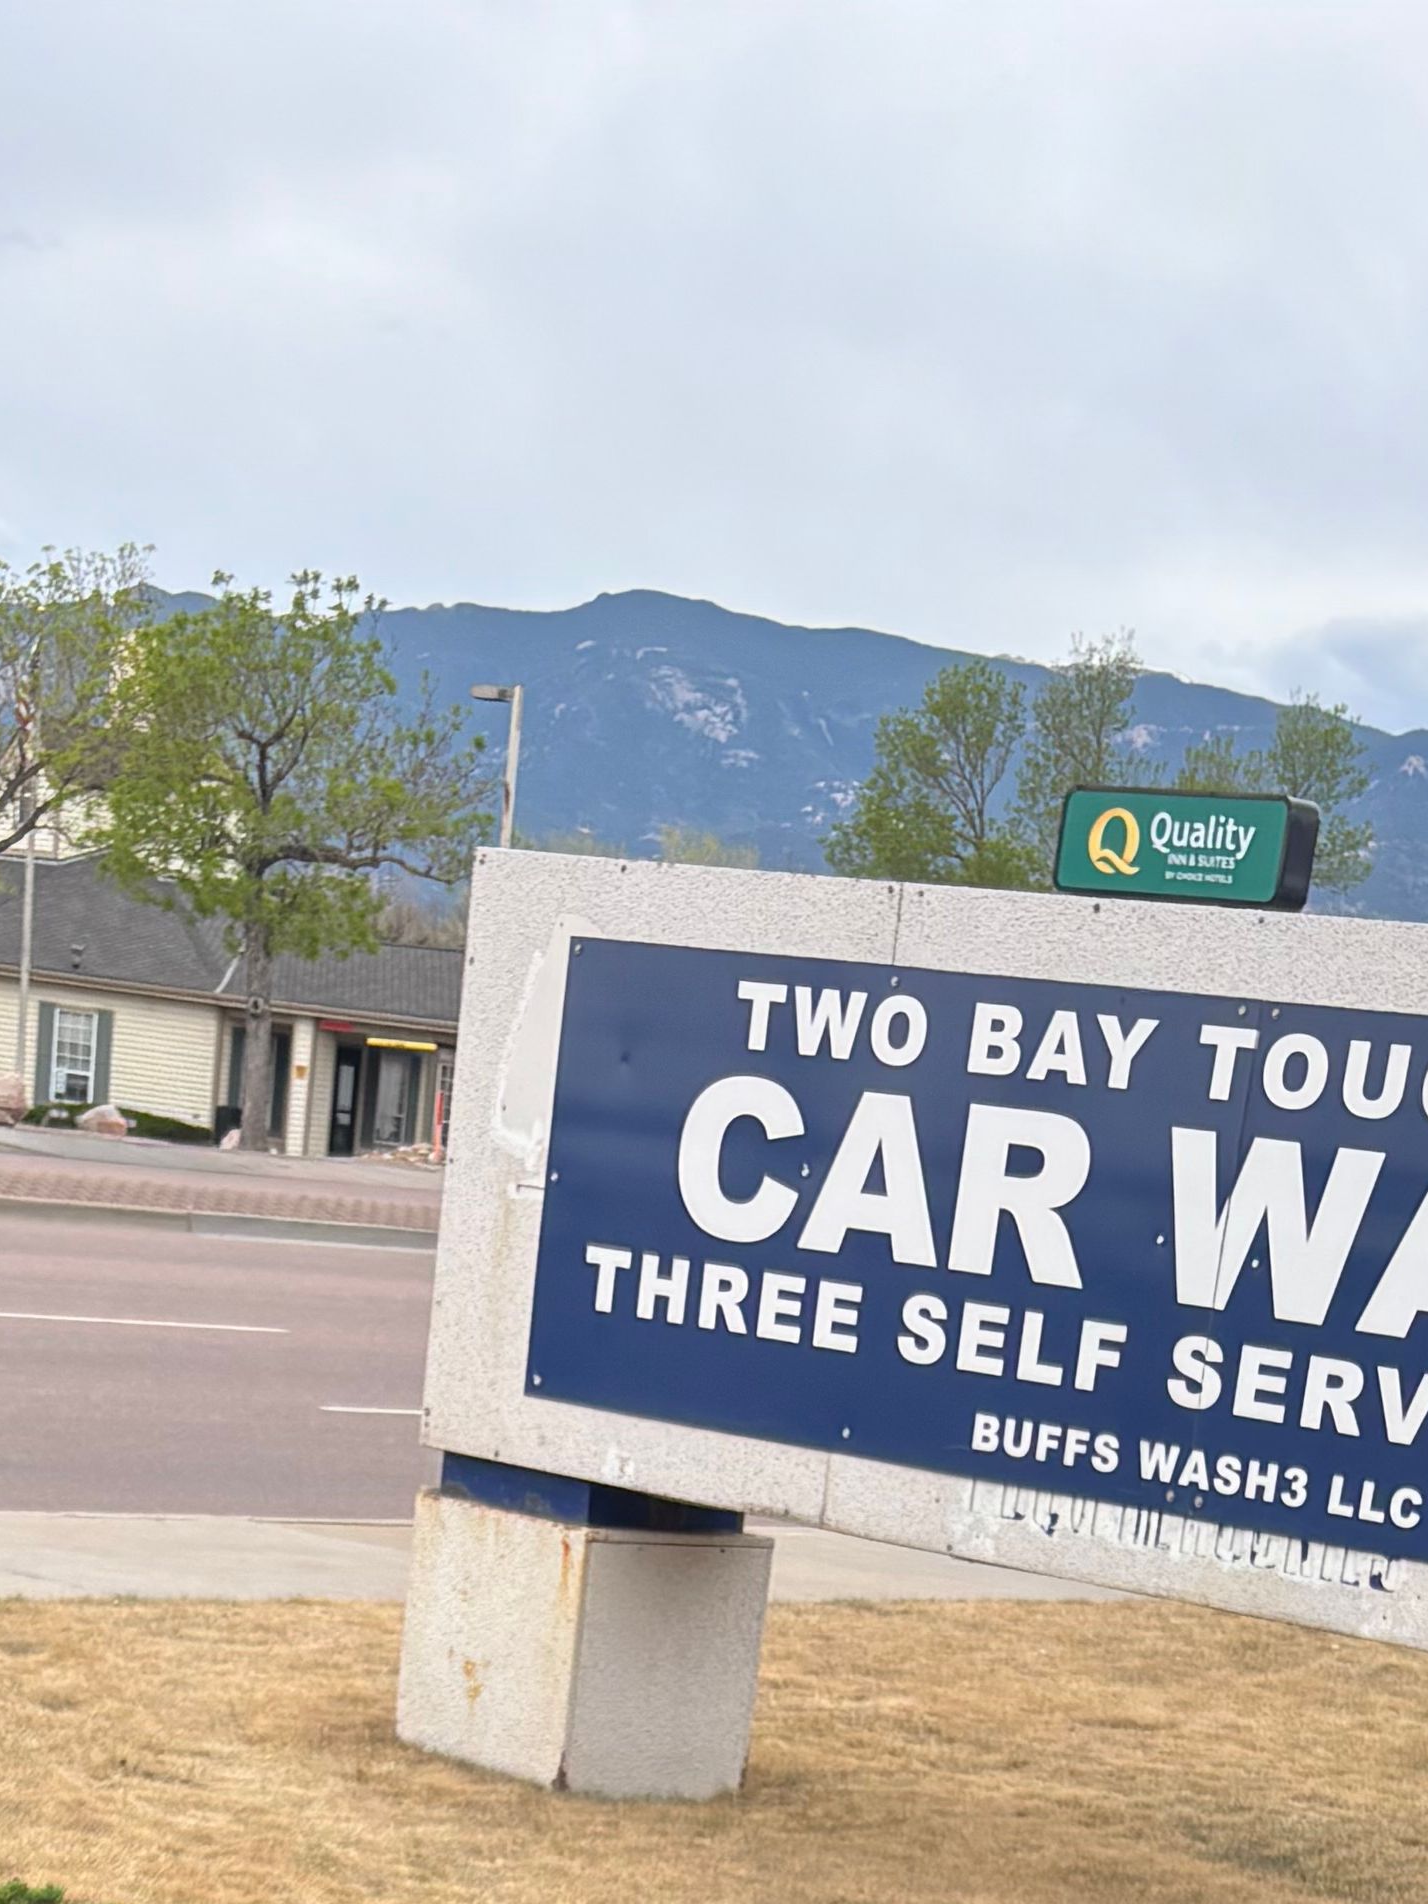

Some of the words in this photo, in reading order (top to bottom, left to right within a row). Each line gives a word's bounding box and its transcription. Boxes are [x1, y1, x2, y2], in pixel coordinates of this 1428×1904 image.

[1150, 811, 1256, 860] Quality
[737, 980, 928, 1067] TWO
[967, 1002, 1160, 1090] BAY
[677, 1075, 1091, 1290] CAR
[585, 1244, 864, 1354] THREE
[897, 1294, 1128, 1392] SELF
[971, 1412, 1120, 1473] BUFFS
[1139, 1439, 1309, 1508] WASH3
[1327, 1475, 1424, 1529] LLC
